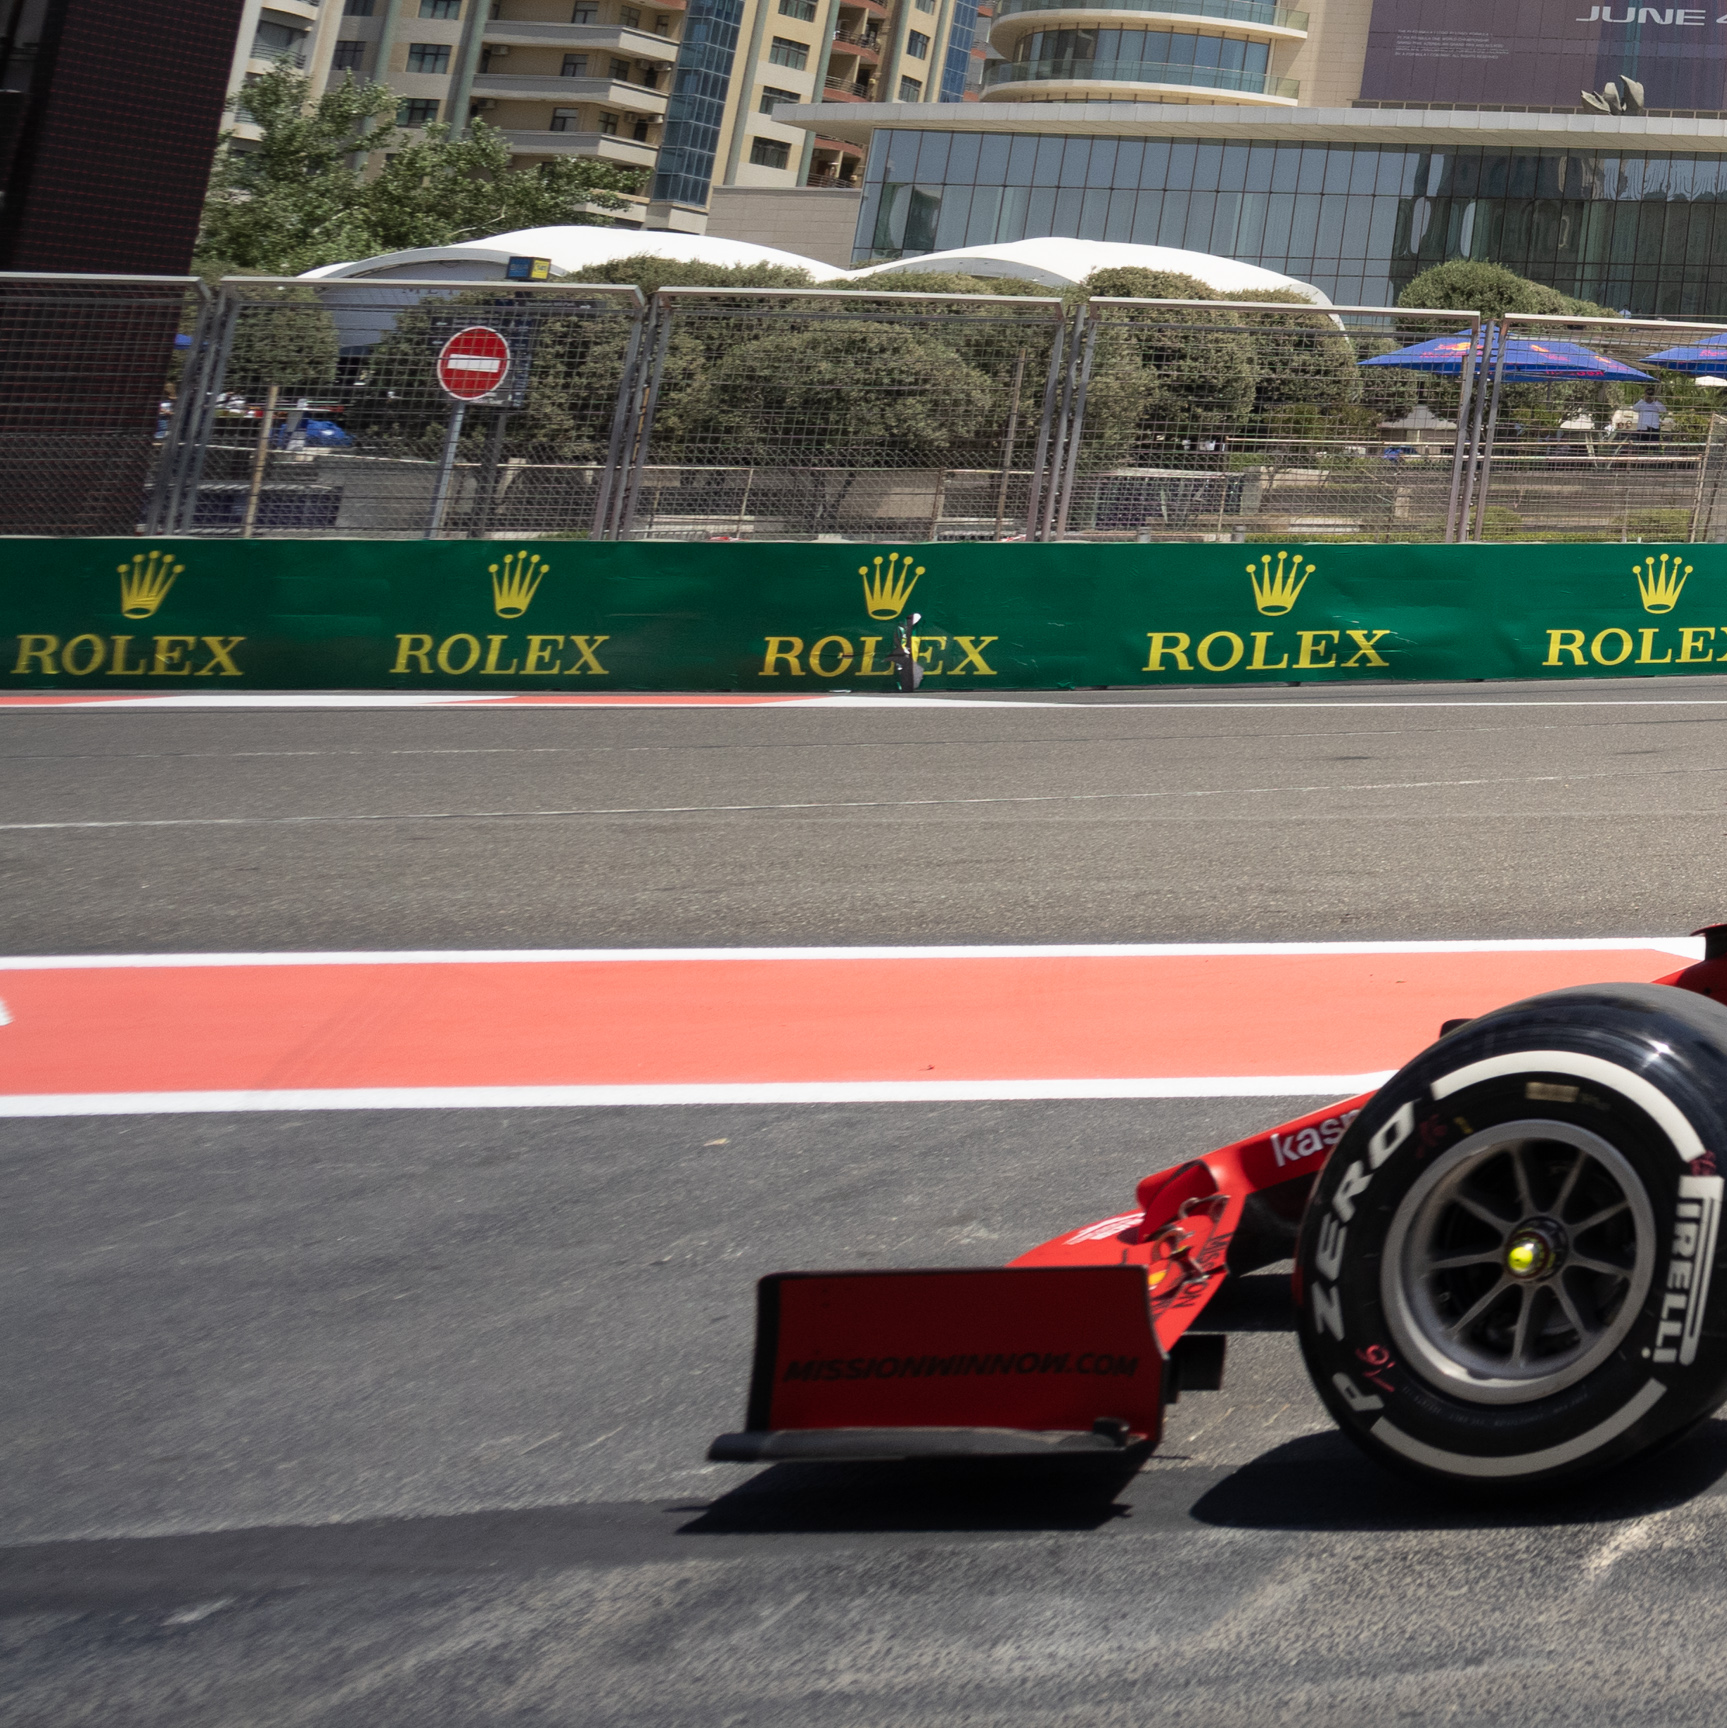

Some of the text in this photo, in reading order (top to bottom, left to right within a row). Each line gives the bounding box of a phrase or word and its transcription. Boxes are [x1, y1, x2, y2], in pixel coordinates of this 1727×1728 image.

[1576, 5, 1706, 27] JUNE
[10, 634, 247, 677] ROLEX
[389, 633, 610, 676] ROLEX
[1142, 629, 1392, 672] ROLEX
[1311, 1097, 1425, 1413] P ZERO
[1652, 1175, 1725, 1366] PIRELLI
[781, 1351, 1140, 1383] MISSIONWINNOW.COM
